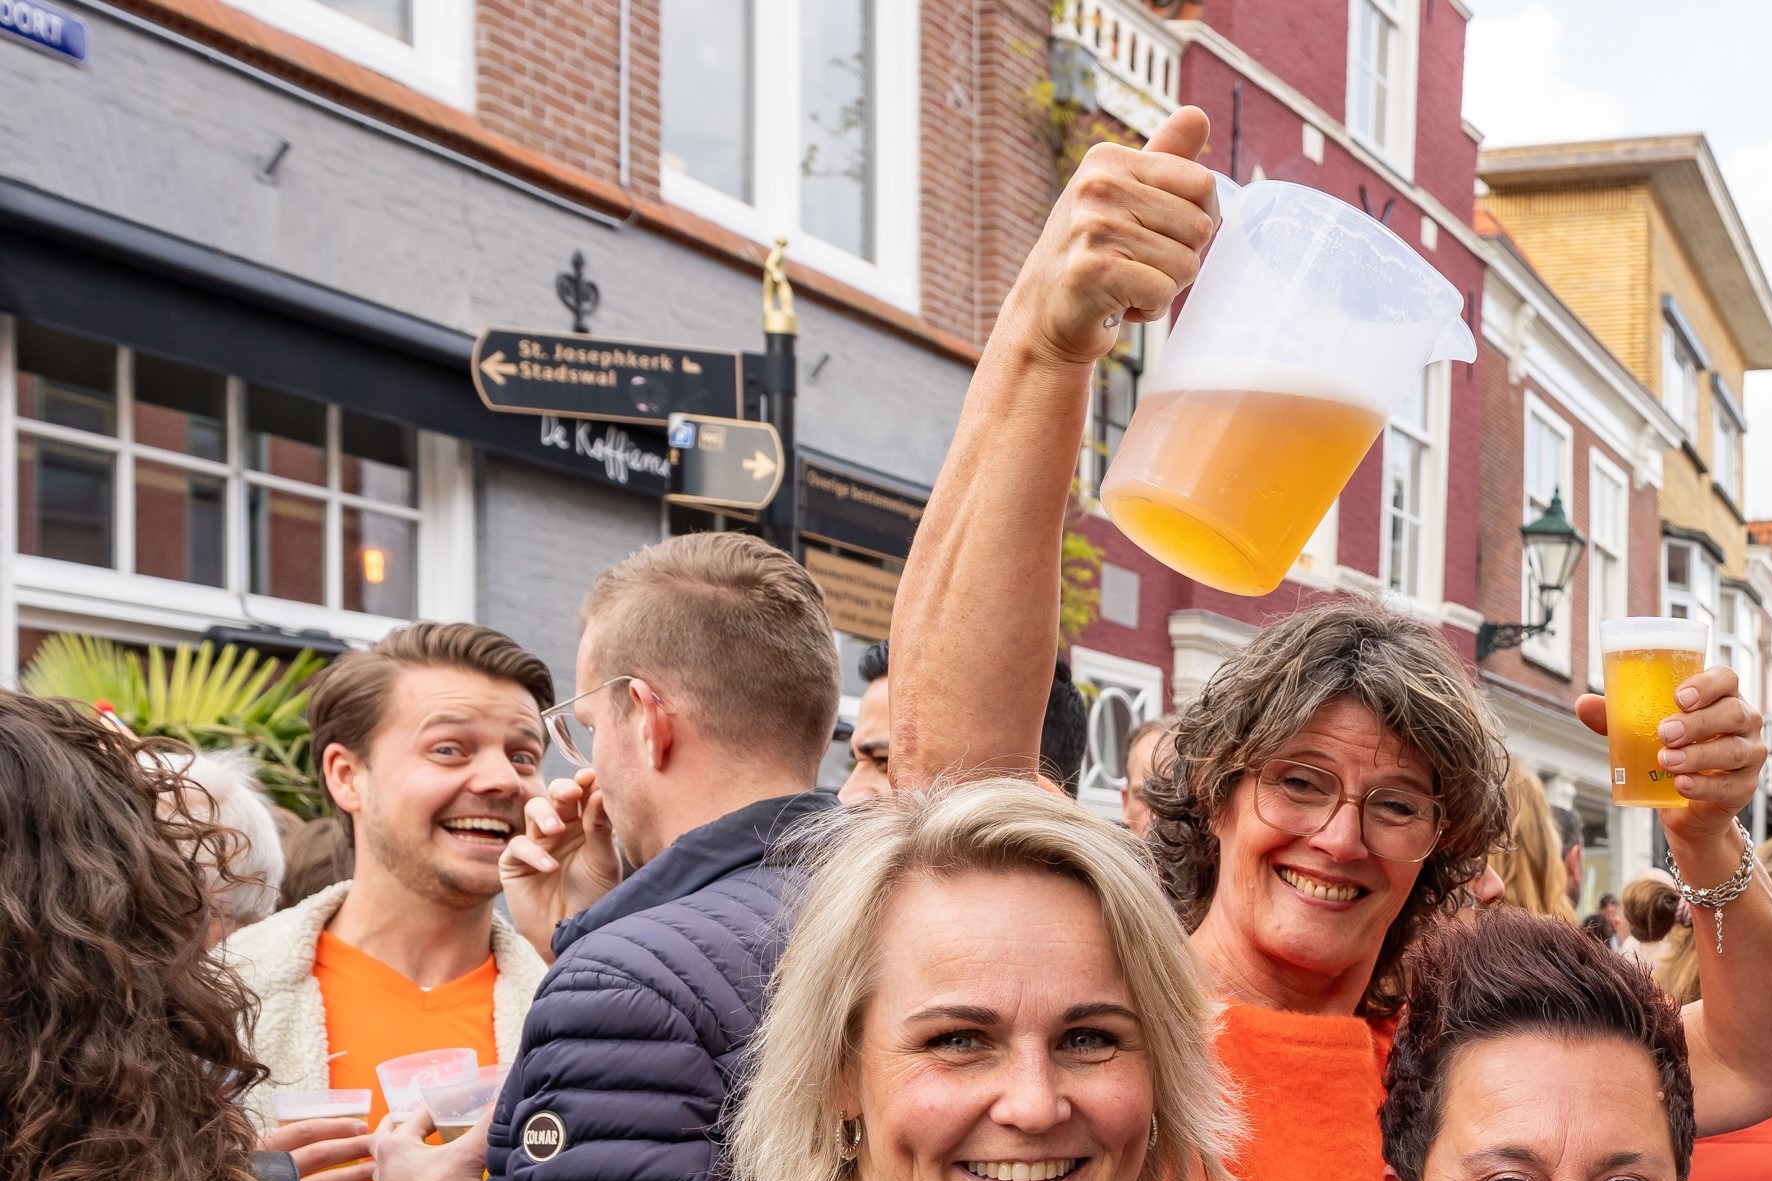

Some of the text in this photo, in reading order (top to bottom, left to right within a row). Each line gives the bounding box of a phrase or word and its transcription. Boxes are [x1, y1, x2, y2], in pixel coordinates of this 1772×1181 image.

[518, 339, 674, 373] St. Josephkerk
[518, 360, 618, 388] Stadswal
[525, 1129, 558, 1145] COLMAR
